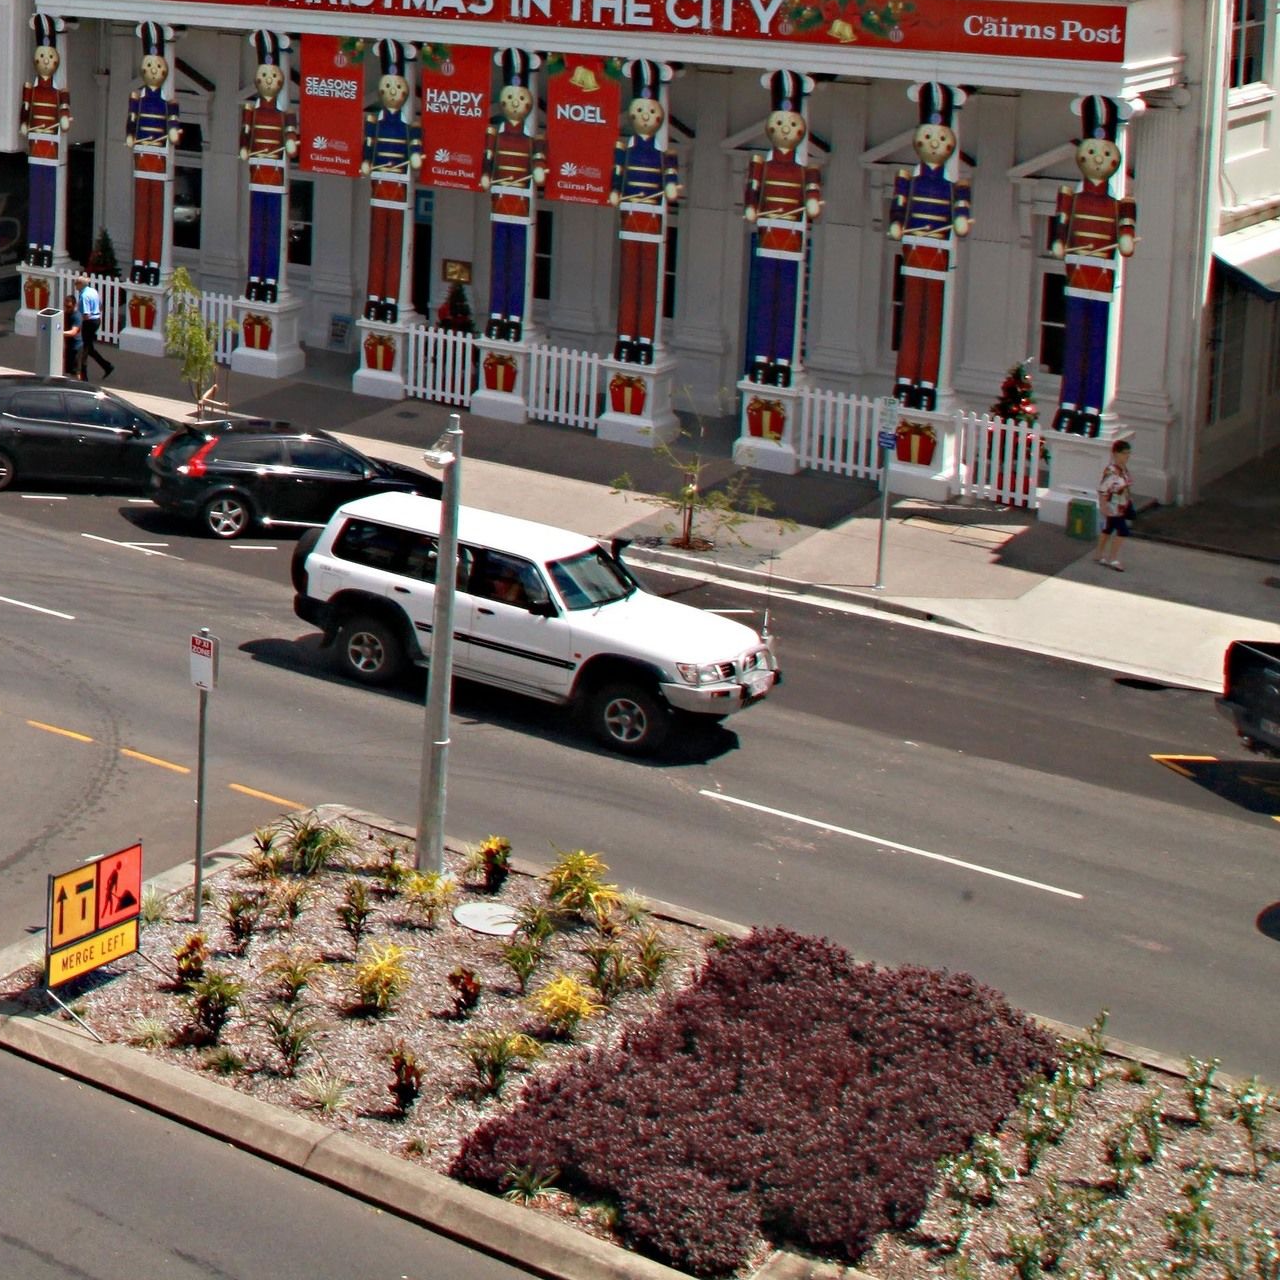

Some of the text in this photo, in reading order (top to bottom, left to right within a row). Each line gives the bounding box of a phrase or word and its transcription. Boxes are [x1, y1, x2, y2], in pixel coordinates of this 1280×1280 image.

[963, 15, 1121, 44] Cairns Post
[305, 76, 358, 91] SEASONS
[305, 86, 357, 100] GREETINGS
[426, 88, 484, 107] HAPPY
[426, 103, 483, 118] NEW YEAR
[61, 932, 125, 972] MERGE LEFT
